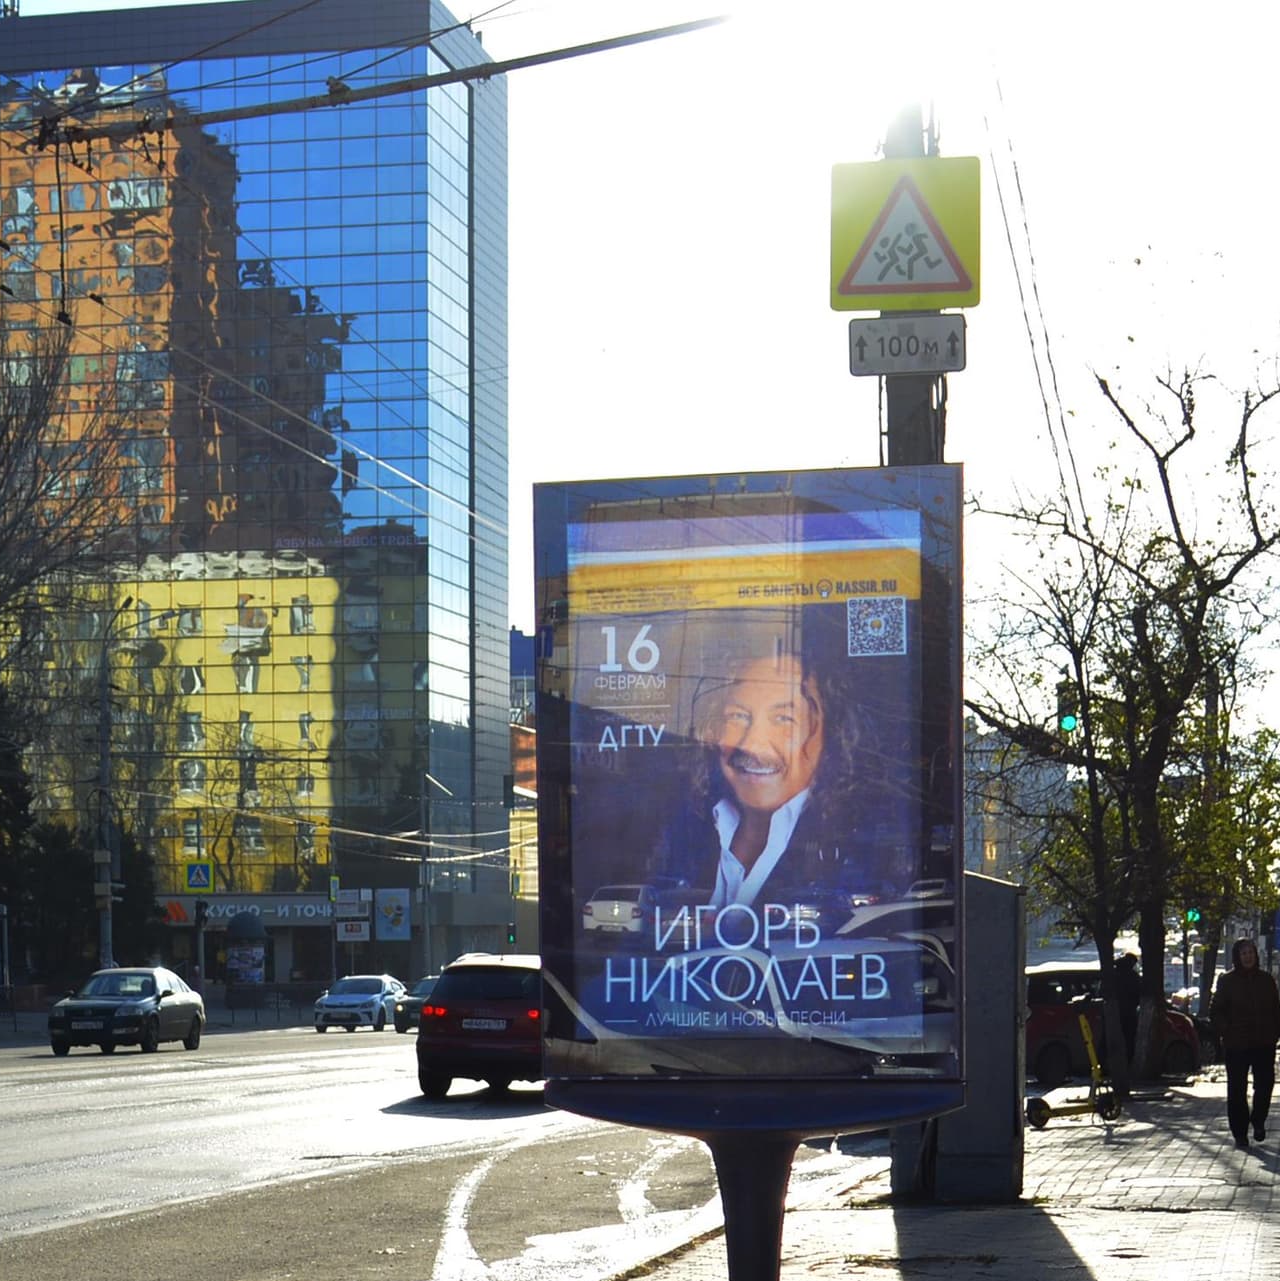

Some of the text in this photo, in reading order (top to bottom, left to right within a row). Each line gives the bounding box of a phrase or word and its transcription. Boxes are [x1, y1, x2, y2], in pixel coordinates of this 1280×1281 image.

[738, 585, 760, 598] ВСЕ
[599, 624, 660, 672] 16
[594, 674, 666, 690] ФЕВРАЛЯ
[598, 723, 666, 752] ДГТУ
[204, 904, 260, 917] КУСНО
[655, 902, 821, 952] ИГОРЬ
[605, 953, 888, 1003] НИКОЛАЕВ
[645, 1010, 846, 1027] ЛУЧШИЕ И НОВЫЕ ПЕСНИ
